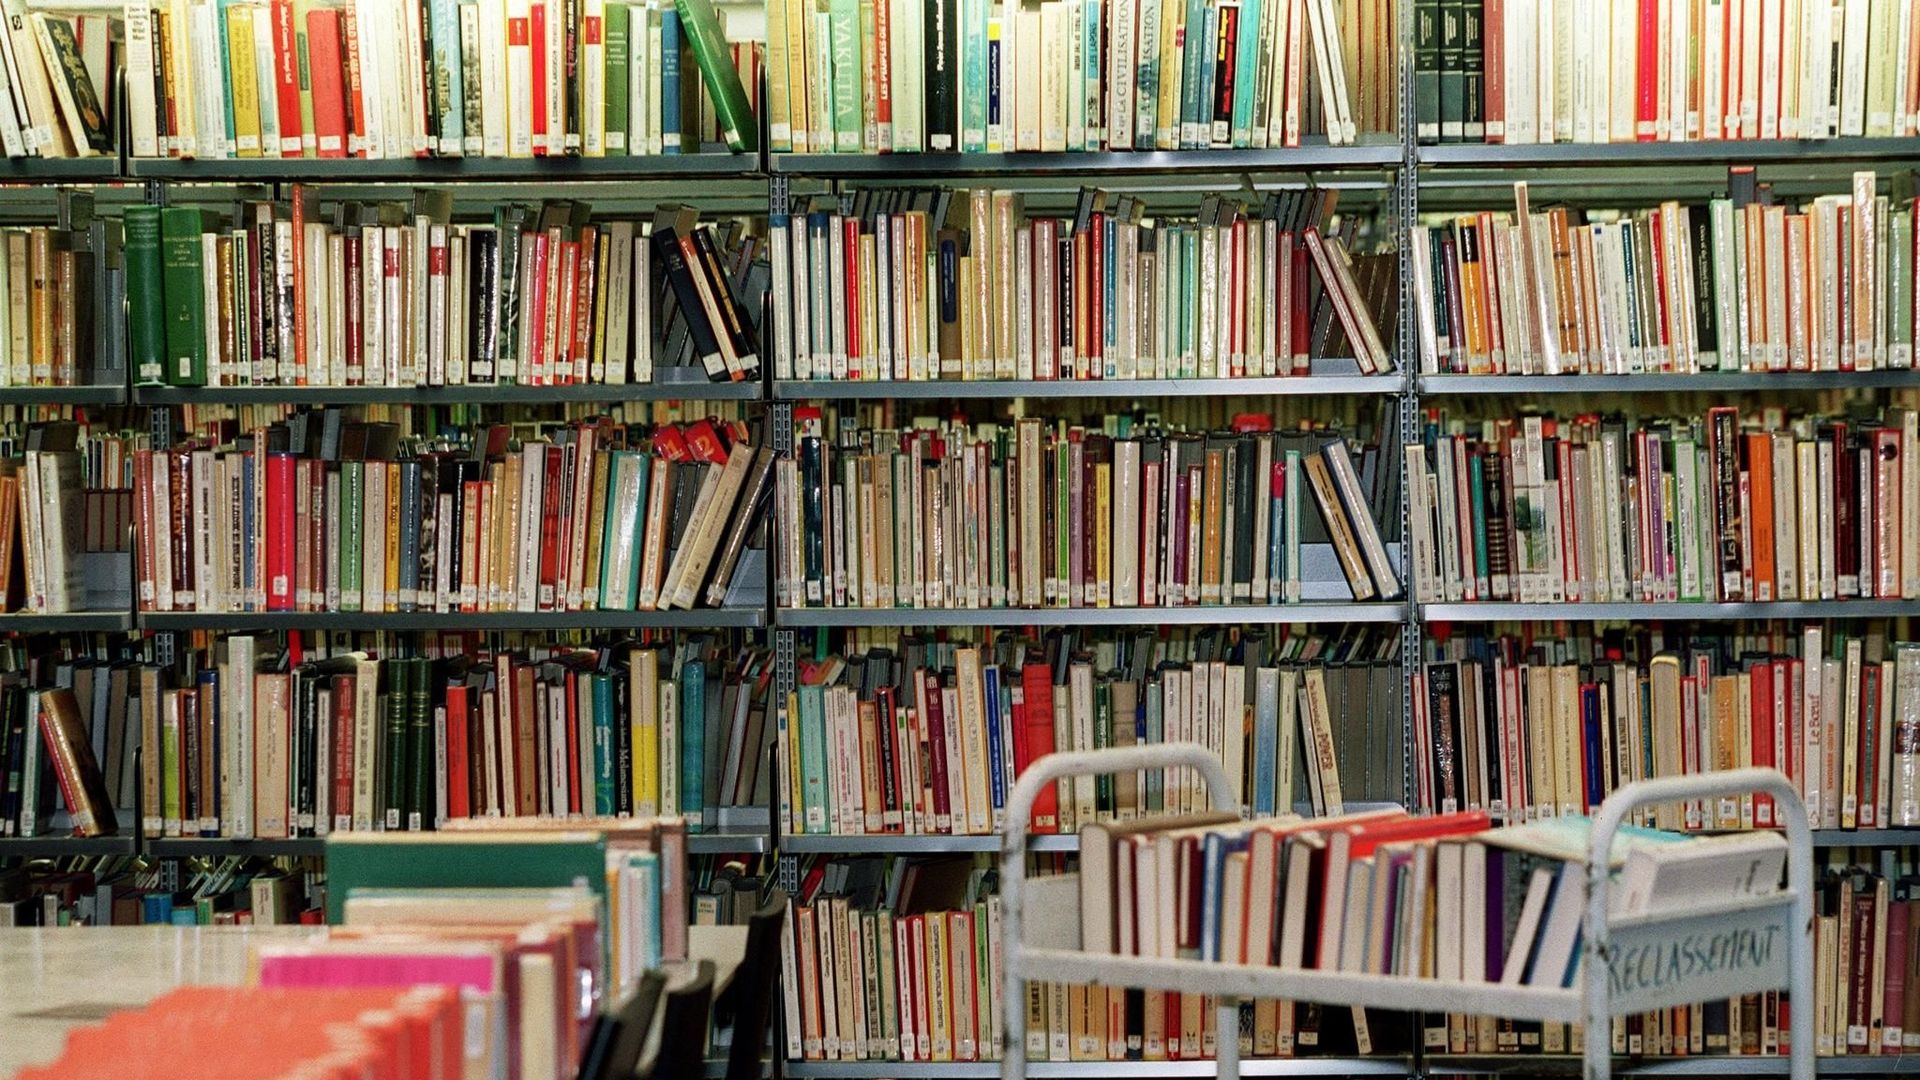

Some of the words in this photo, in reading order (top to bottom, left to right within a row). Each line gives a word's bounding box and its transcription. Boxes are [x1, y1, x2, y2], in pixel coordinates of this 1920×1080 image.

[1089, 23, 1097, 53] LAPONS
[835, 17, 853, 117] YAKUTIA
[1089, 54, 1097, 67] LES
[695, 434, 715, 457] 2
[172, 494, 181, 535] VALLEY
[1807, 694, 1819, 728] Bœuf
[1316, 733, 1333, 770] POWER
[1808, 731, 1819, 745] Le
[619, 749, 629, 809] Melanesians
[1606, 924, 1780, 1001] RECLASSEMENT
